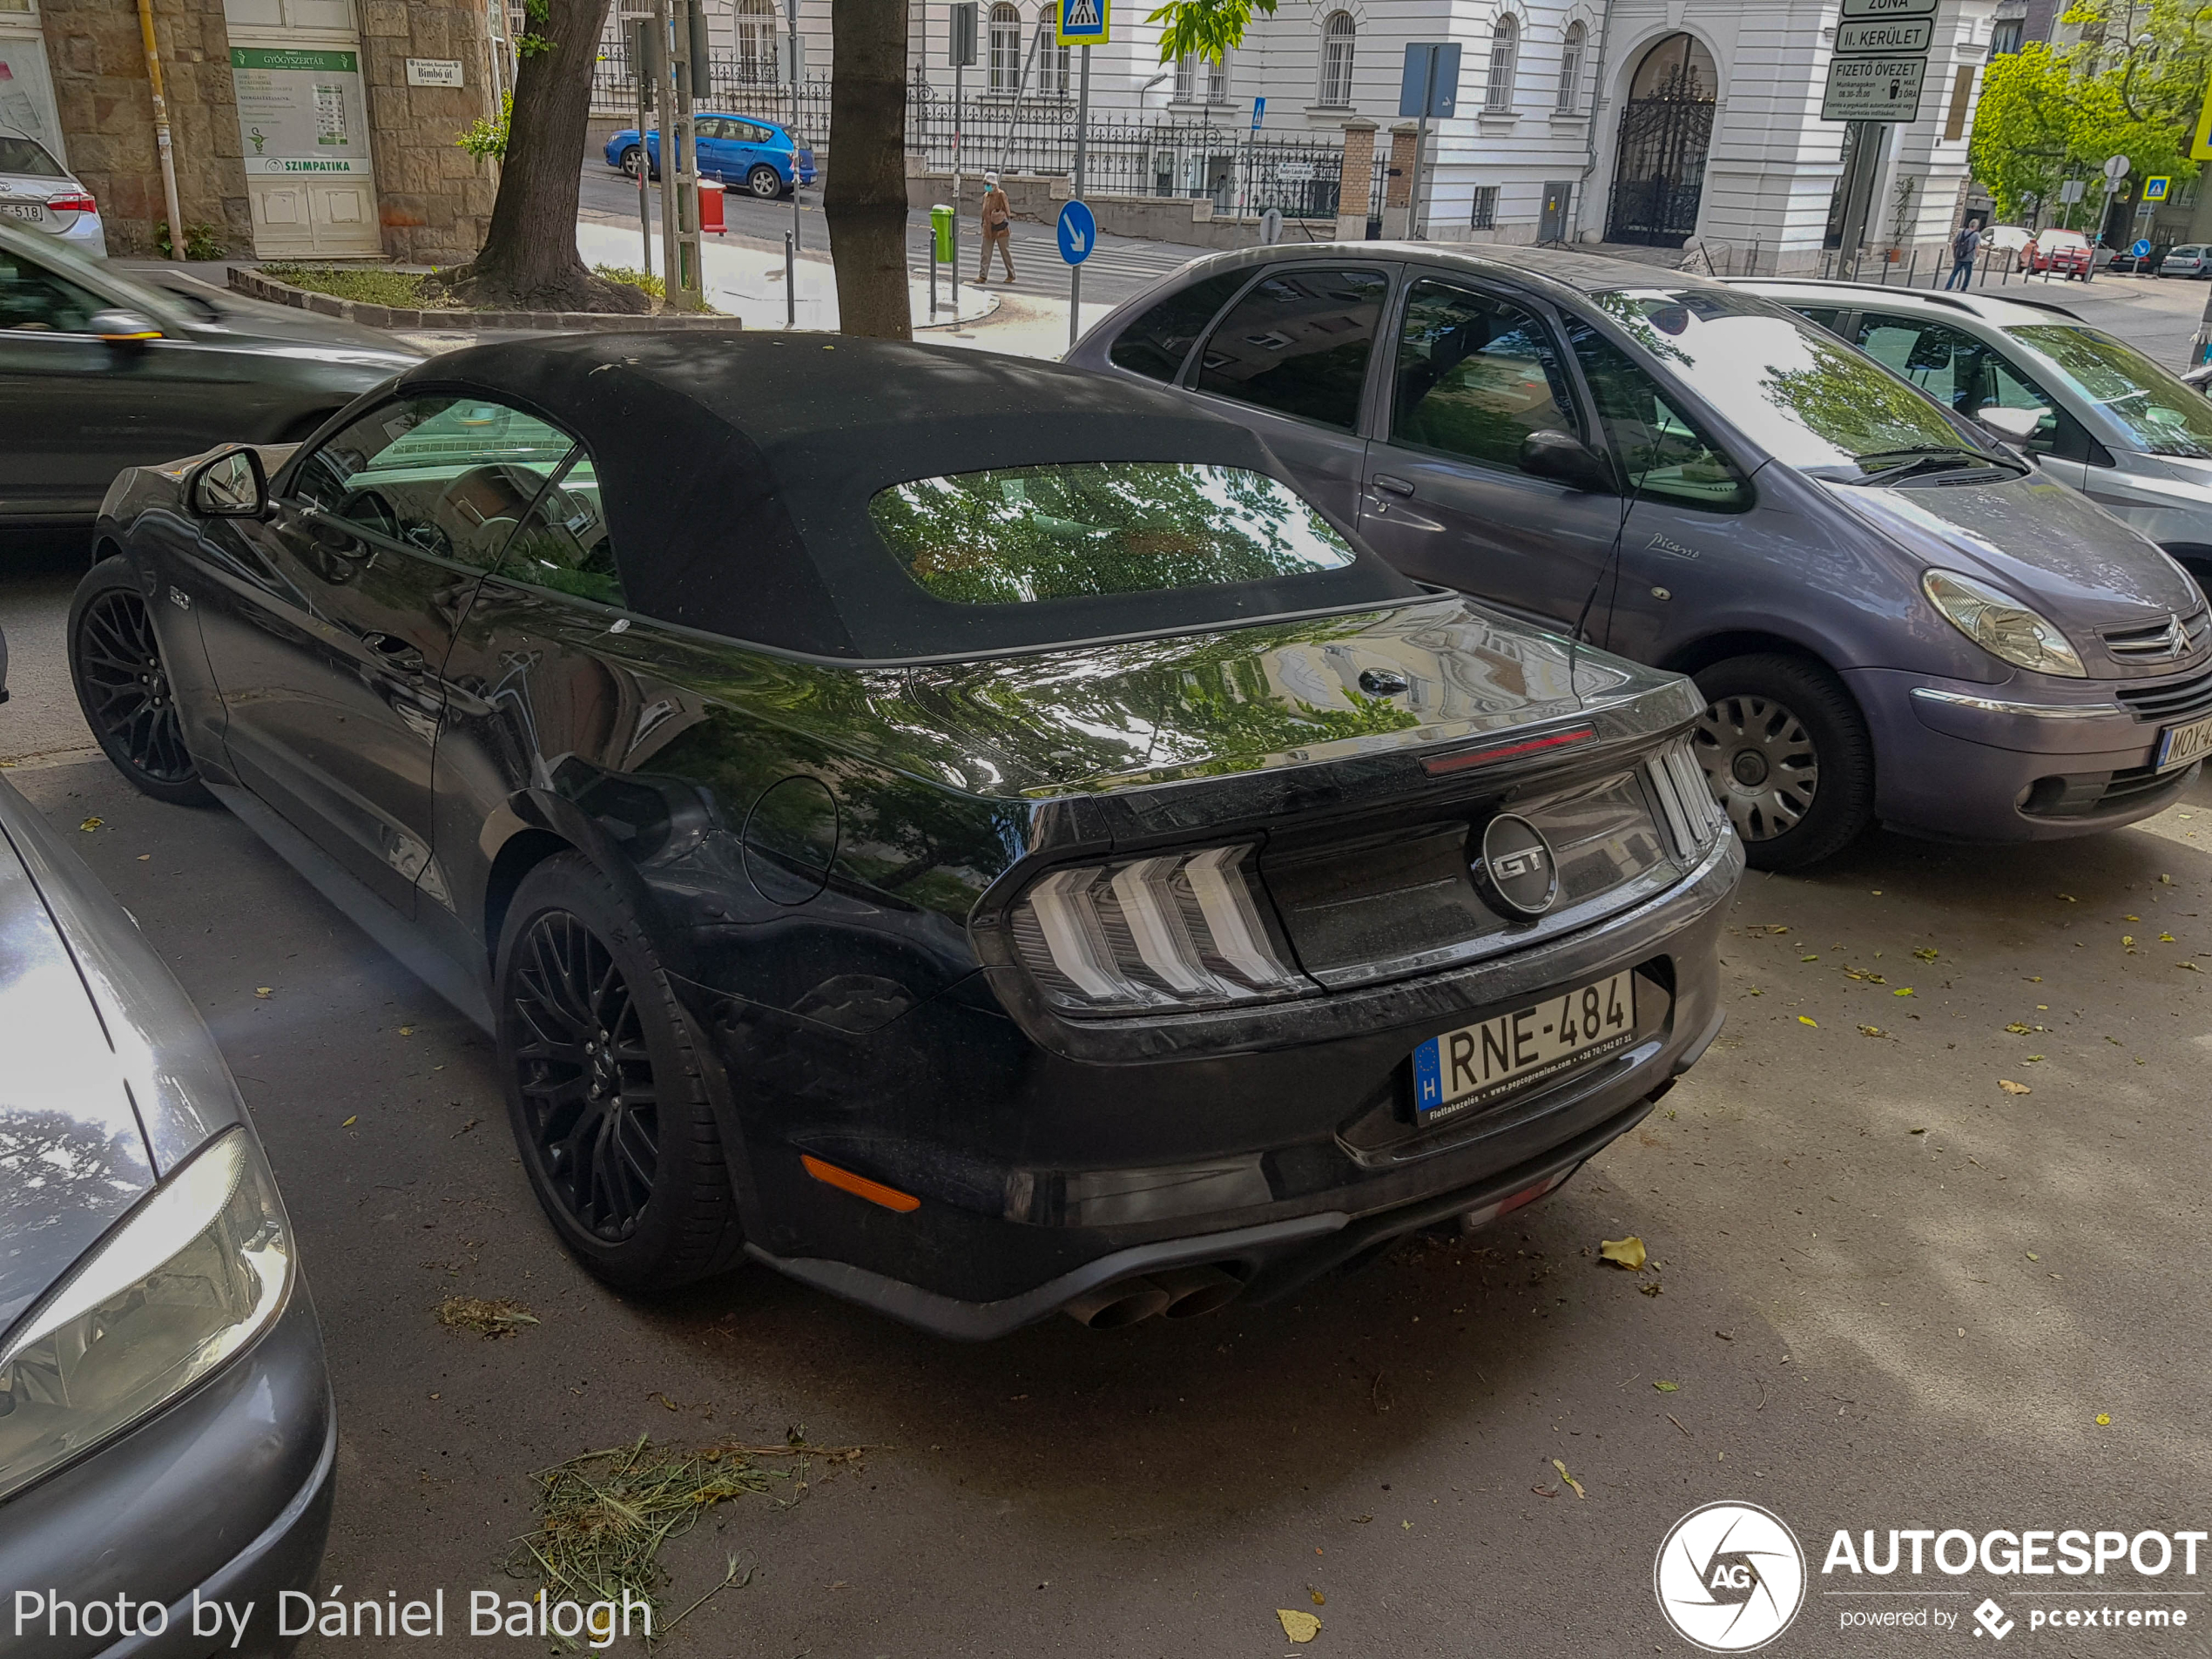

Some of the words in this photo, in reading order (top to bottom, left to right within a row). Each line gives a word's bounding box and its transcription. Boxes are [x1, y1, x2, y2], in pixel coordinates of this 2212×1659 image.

[1844, 31, 1856, 46] II.
[1859, 26, 1922, 45] KERÜLET
[263, 55, 325, 65] GYÓGYSZERTÁR
[1836, 61, 1872, 77] FIZETŐ
[1875, 61, 1918, 77] ÖVEZET
[418, 68, 443, 78] Bimbó
[444, 69, 453, 78] út
[1904, 88, 1917, 98] ÓRA
[285, 160, 350, 172] SZIMPATIKA
[1642, 532, 1701, 559] Picasso
[2168, 721, 2212, 761] MOX-4
[1493, 845, 1544, 880] GT
[1449, 976, 1624, 1093] RNE-484
[1429, 1096, 1479, 1121] Flottakezelés
[1579, 1050, 1591, 1061] +36
[1615, 1037, 1623, 1047] 07
[1624, 1034, 1632, 1043] 31
[1423, 1077, 1435, 1101] H
